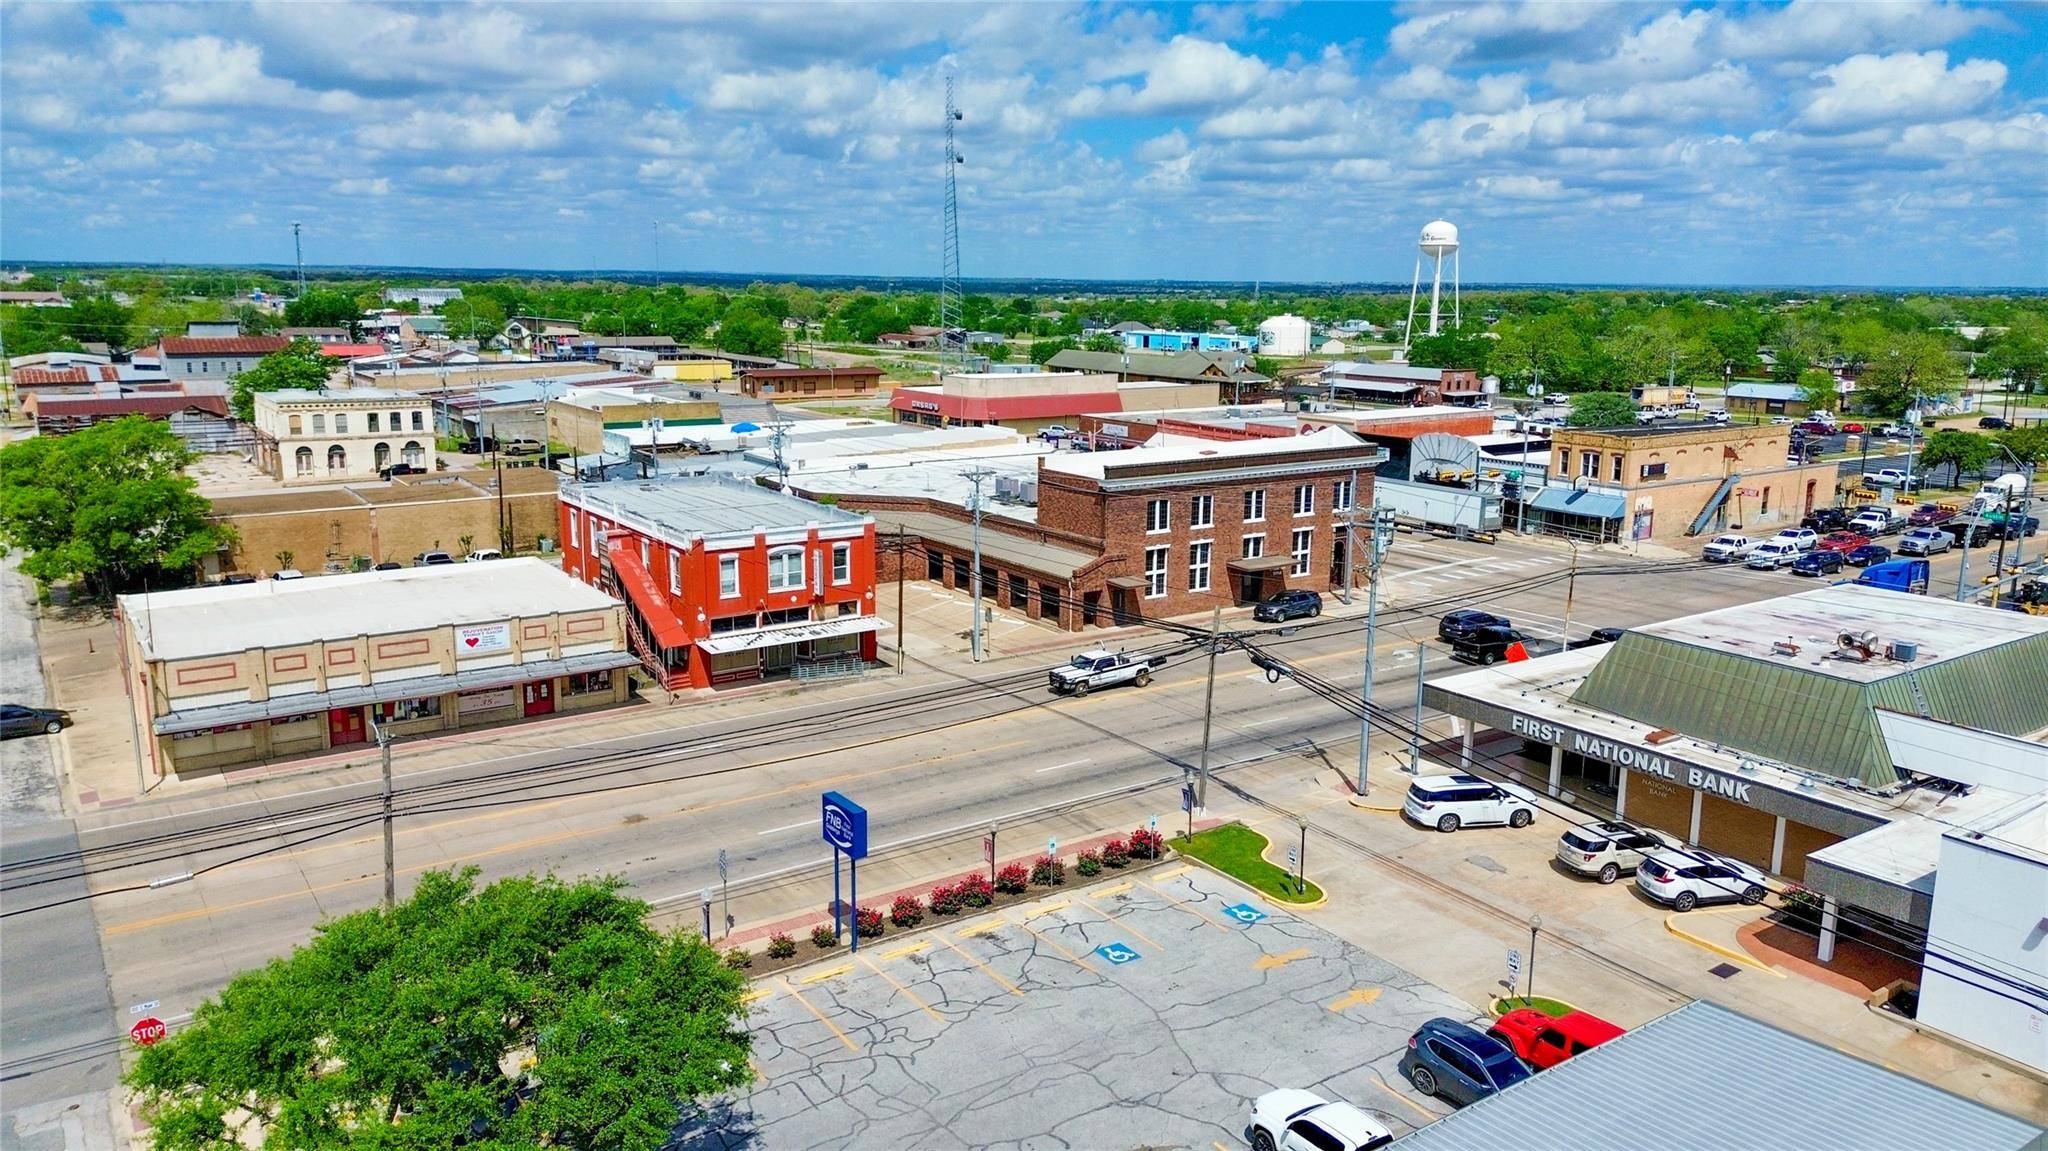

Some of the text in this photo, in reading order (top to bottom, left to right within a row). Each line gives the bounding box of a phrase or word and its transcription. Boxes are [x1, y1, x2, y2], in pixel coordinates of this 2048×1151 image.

[1512, 715, 1752, 802] FIRST NATIONAL BANK
[1642, 779, 1676, 794] NATIONAL
[1649, 789, 1669, 800] BANK
[826, 811, 842, 830] FNB
[133, 1024, 164, 1041] STOP
